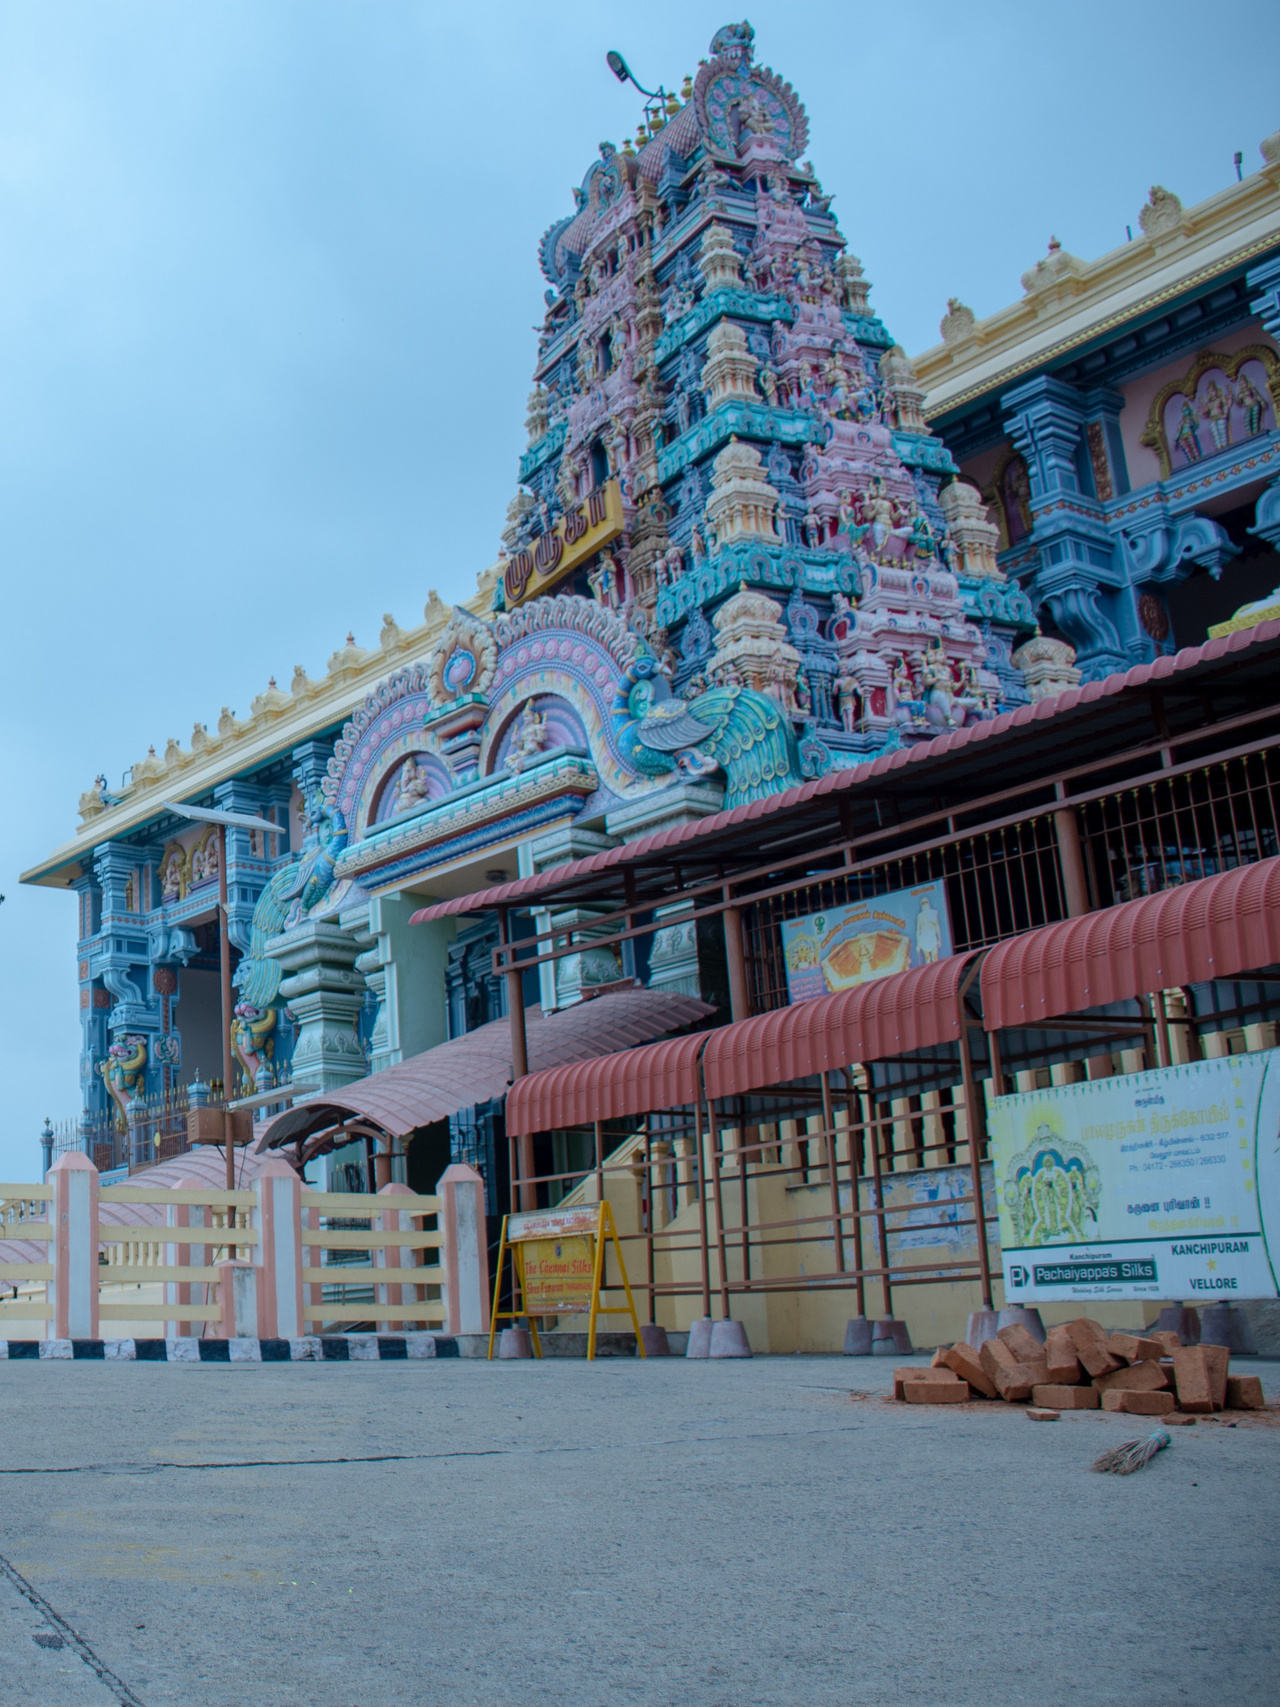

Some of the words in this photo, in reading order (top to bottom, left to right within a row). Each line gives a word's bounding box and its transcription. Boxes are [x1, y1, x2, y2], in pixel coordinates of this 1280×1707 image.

[504, 487, 607, 601] முருகா
[1200, 1133, 1215, 1141] 632
[1069, 1252, 1112, 1260] Kanchipuram
[1171, 1241, 1249, 1256] KANCHIPURAM
[526, 1261, 537, 1275] The
[539, 1260, 570, 1274] Chennai
[572, 1259, 592, 1274] Silks
[1036, 1266, 1118, 1282] Pachaiyappa's
[1121, 1263, 1153, 1277] Silks
[1189, 1278, 1238, 1290] VELLORE
